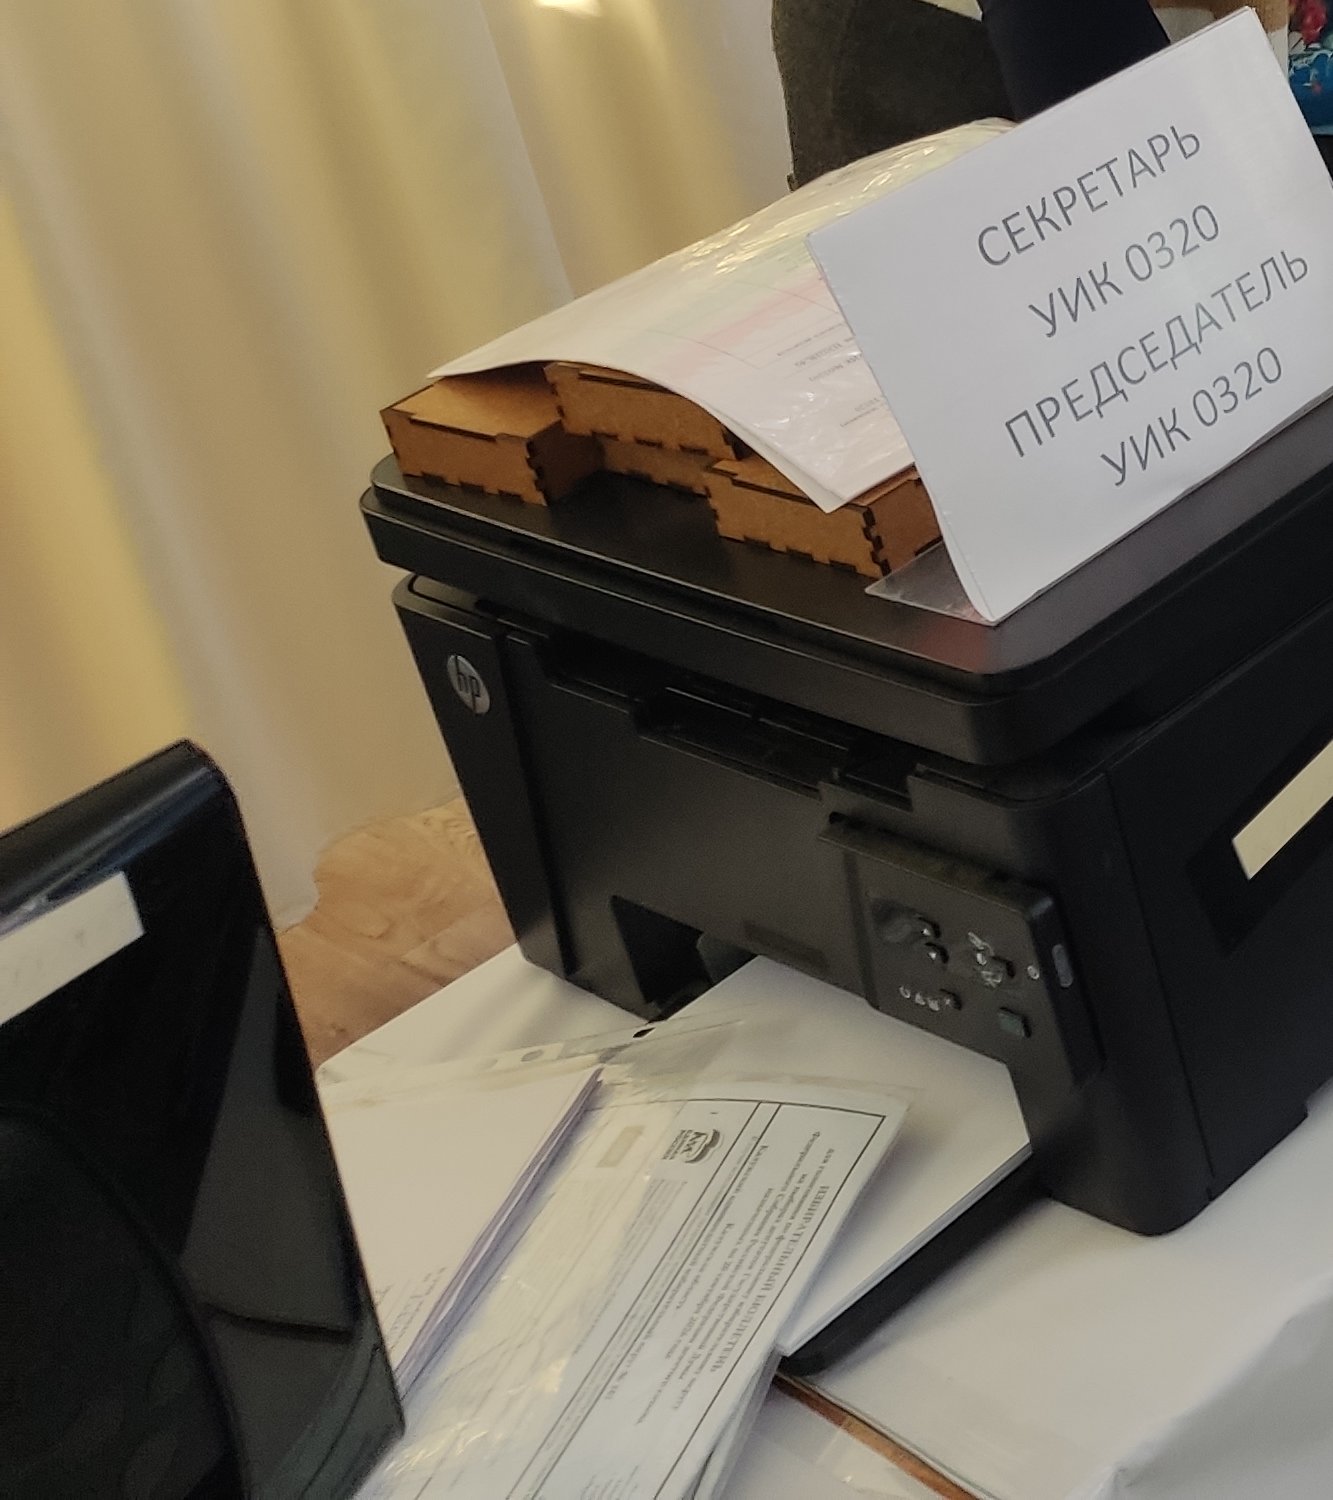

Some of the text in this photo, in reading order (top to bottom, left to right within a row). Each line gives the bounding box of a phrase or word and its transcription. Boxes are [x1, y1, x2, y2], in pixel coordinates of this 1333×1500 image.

[977, 124, 1201, 267] СЕКРЕТАРЬ
[1029, 204, 1220, 338] УИК 0320
[1004, 249, 1309, 457] ПРЕДСЕДАТЕЛЬ
[1100, 346, 1283, 486] УИК 0320
[455, 655, 481, 711] hp
